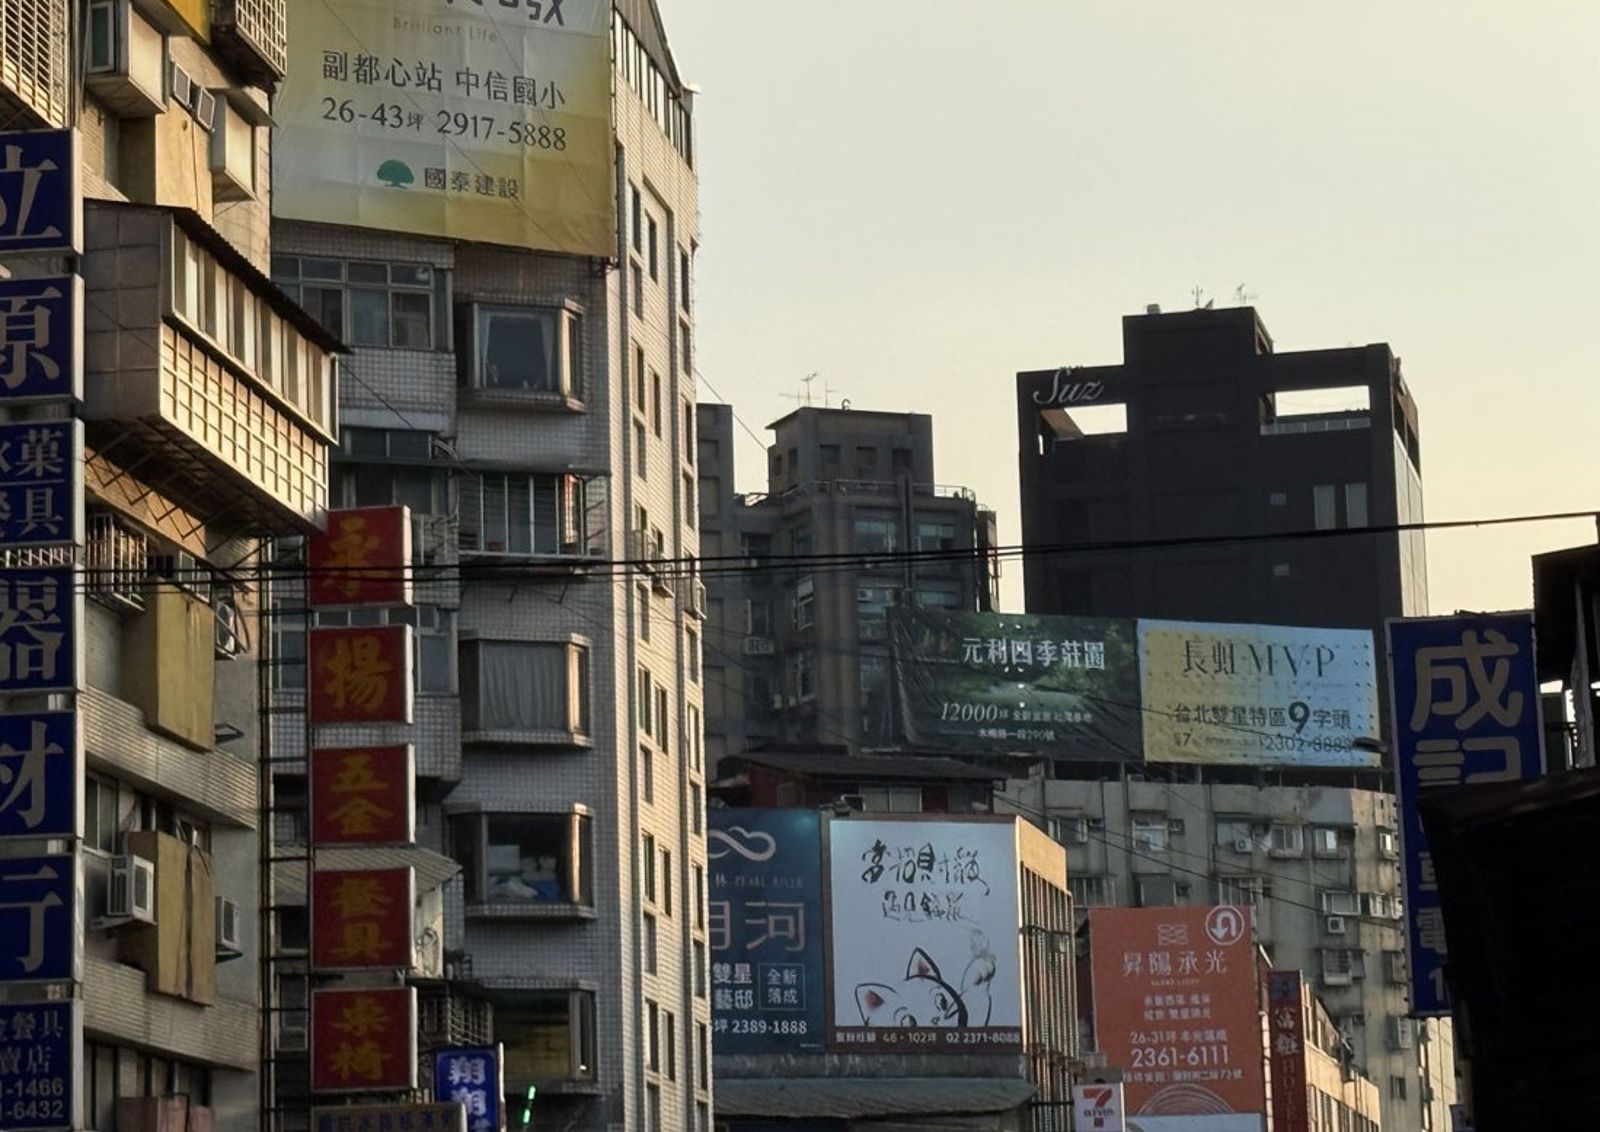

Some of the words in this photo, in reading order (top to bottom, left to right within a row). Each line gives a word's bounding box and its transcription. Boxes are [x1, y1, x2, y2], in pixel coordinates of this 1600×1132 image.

[468, 26, 500, 42] Life
[322, 50, 443, 93] 副都心站
[455, 67, 565, 110] 中信國小
[322, 97, 424, 132] 26-43坪
[436, 110, 567, 151] 2917-5888
[424, 167, 522, 200] 國泰建設
[0, 486, 64, 538] 具
[1183, 640, 1236, 676] 長虹
[1247, 643, 1336, 678] MVP
[712, 963, 753, 985] 雙星
[1122, 952, 1229, 977] 昇陽承光
[732, 1020, 808, 1034] 2389-1888
[1131, 1045, 1229, 1068] 2361-6111
[0, 1078, 64, 1099] -1466
[0, 1099, 64, 1120] -6432
